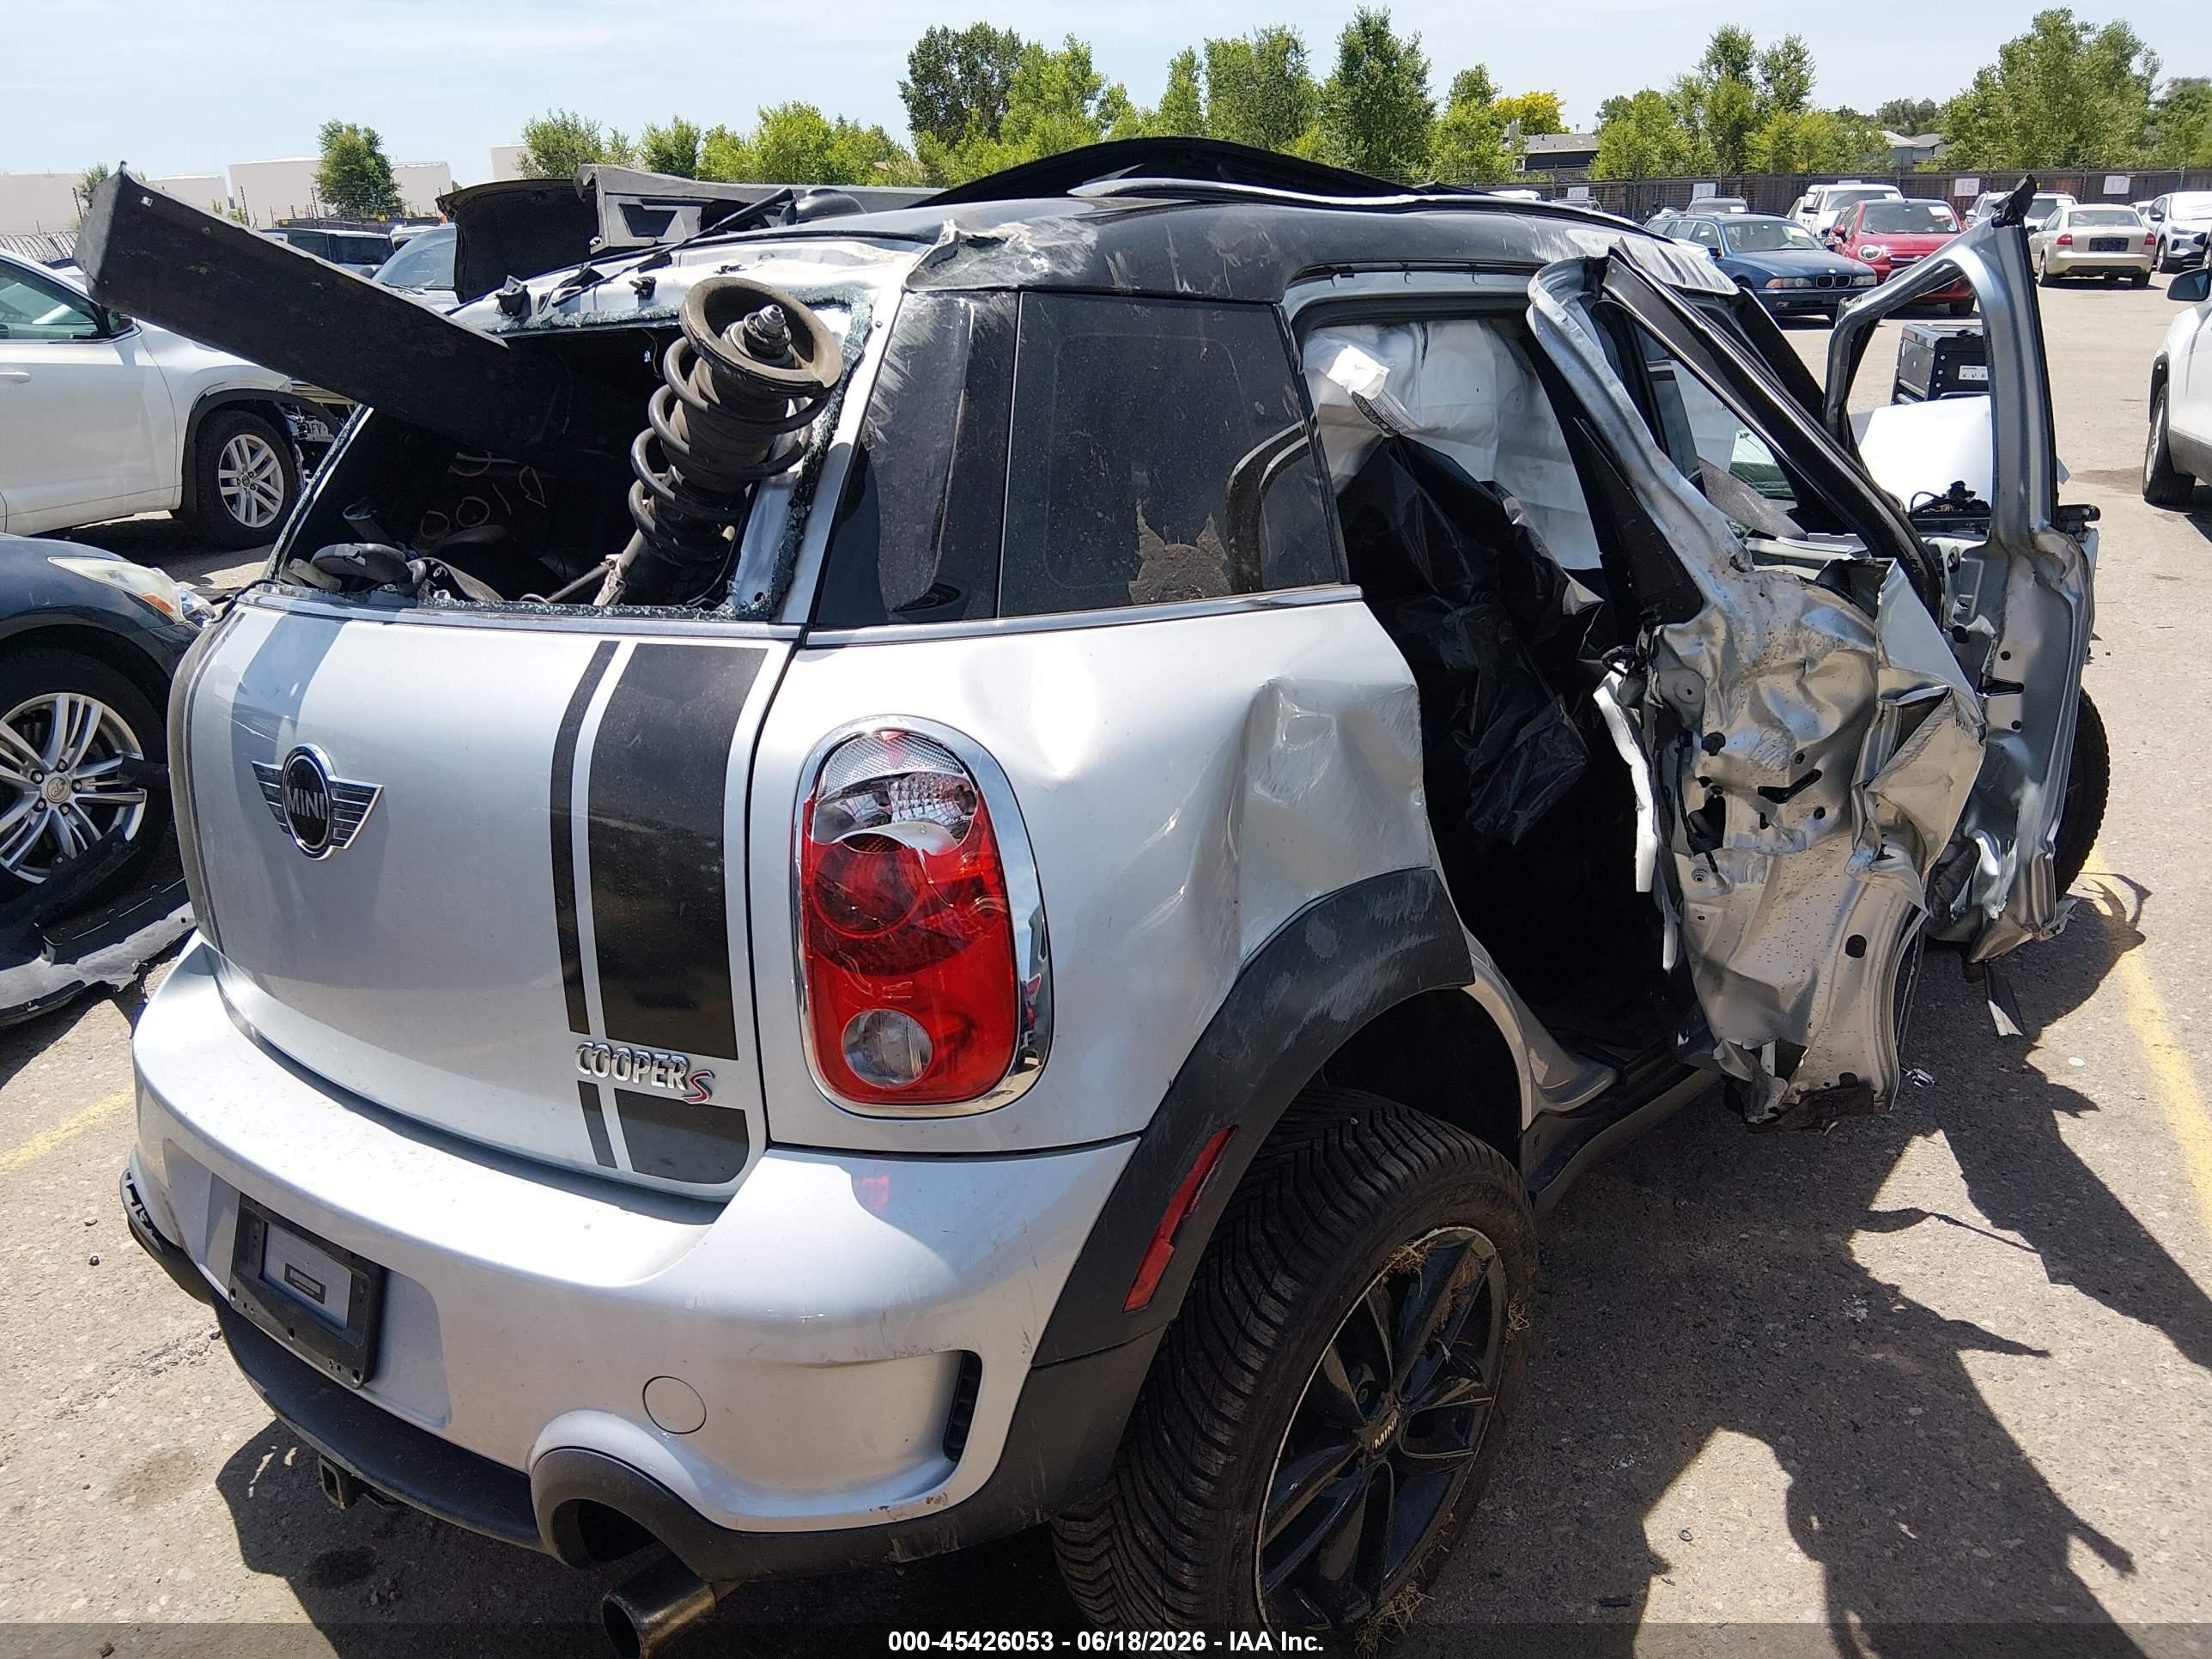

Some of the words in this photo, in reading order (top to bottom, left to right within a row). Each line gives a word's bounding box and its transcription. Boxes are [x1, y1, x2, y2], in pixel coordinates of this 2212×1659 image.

[1959, 179, 1976, 193] 15
[286, 786, 326, 820] MINI
[575, 1040, 690, 1091] COOPER
[681, 1068, 715, 1105] S
[1374, 1417, 1398, 1449] MINI
